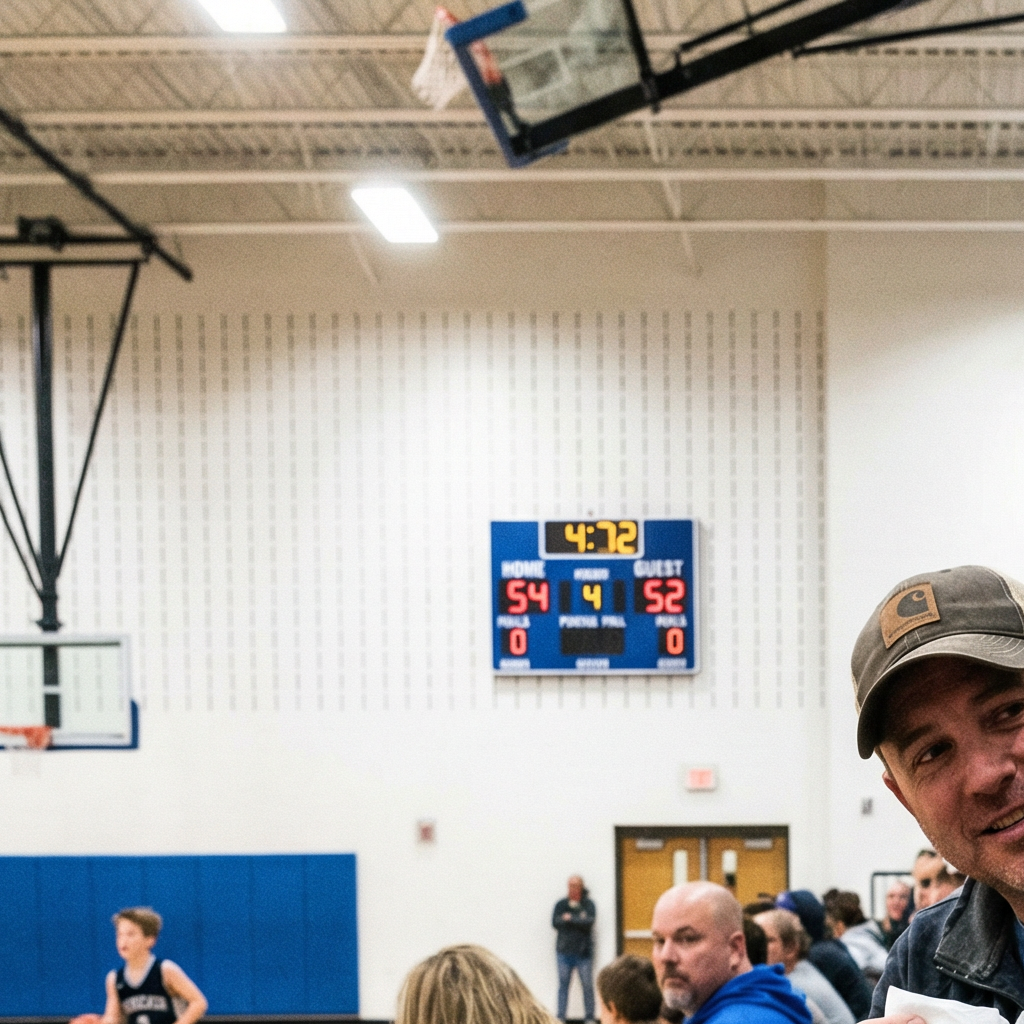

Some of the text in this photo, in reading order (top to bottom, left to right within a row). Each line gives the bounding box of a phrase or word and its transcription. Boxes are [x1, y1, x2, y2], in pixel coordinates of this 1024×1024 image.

[564, 520, 637, 554] 4:72
[506, 579, 549, 614] 54
[582, 584, 602, 610] 4
[643, 578, 686, 614] 52
[509, 627, 527, 655] 0
[666, 627, 684, 655] 0
